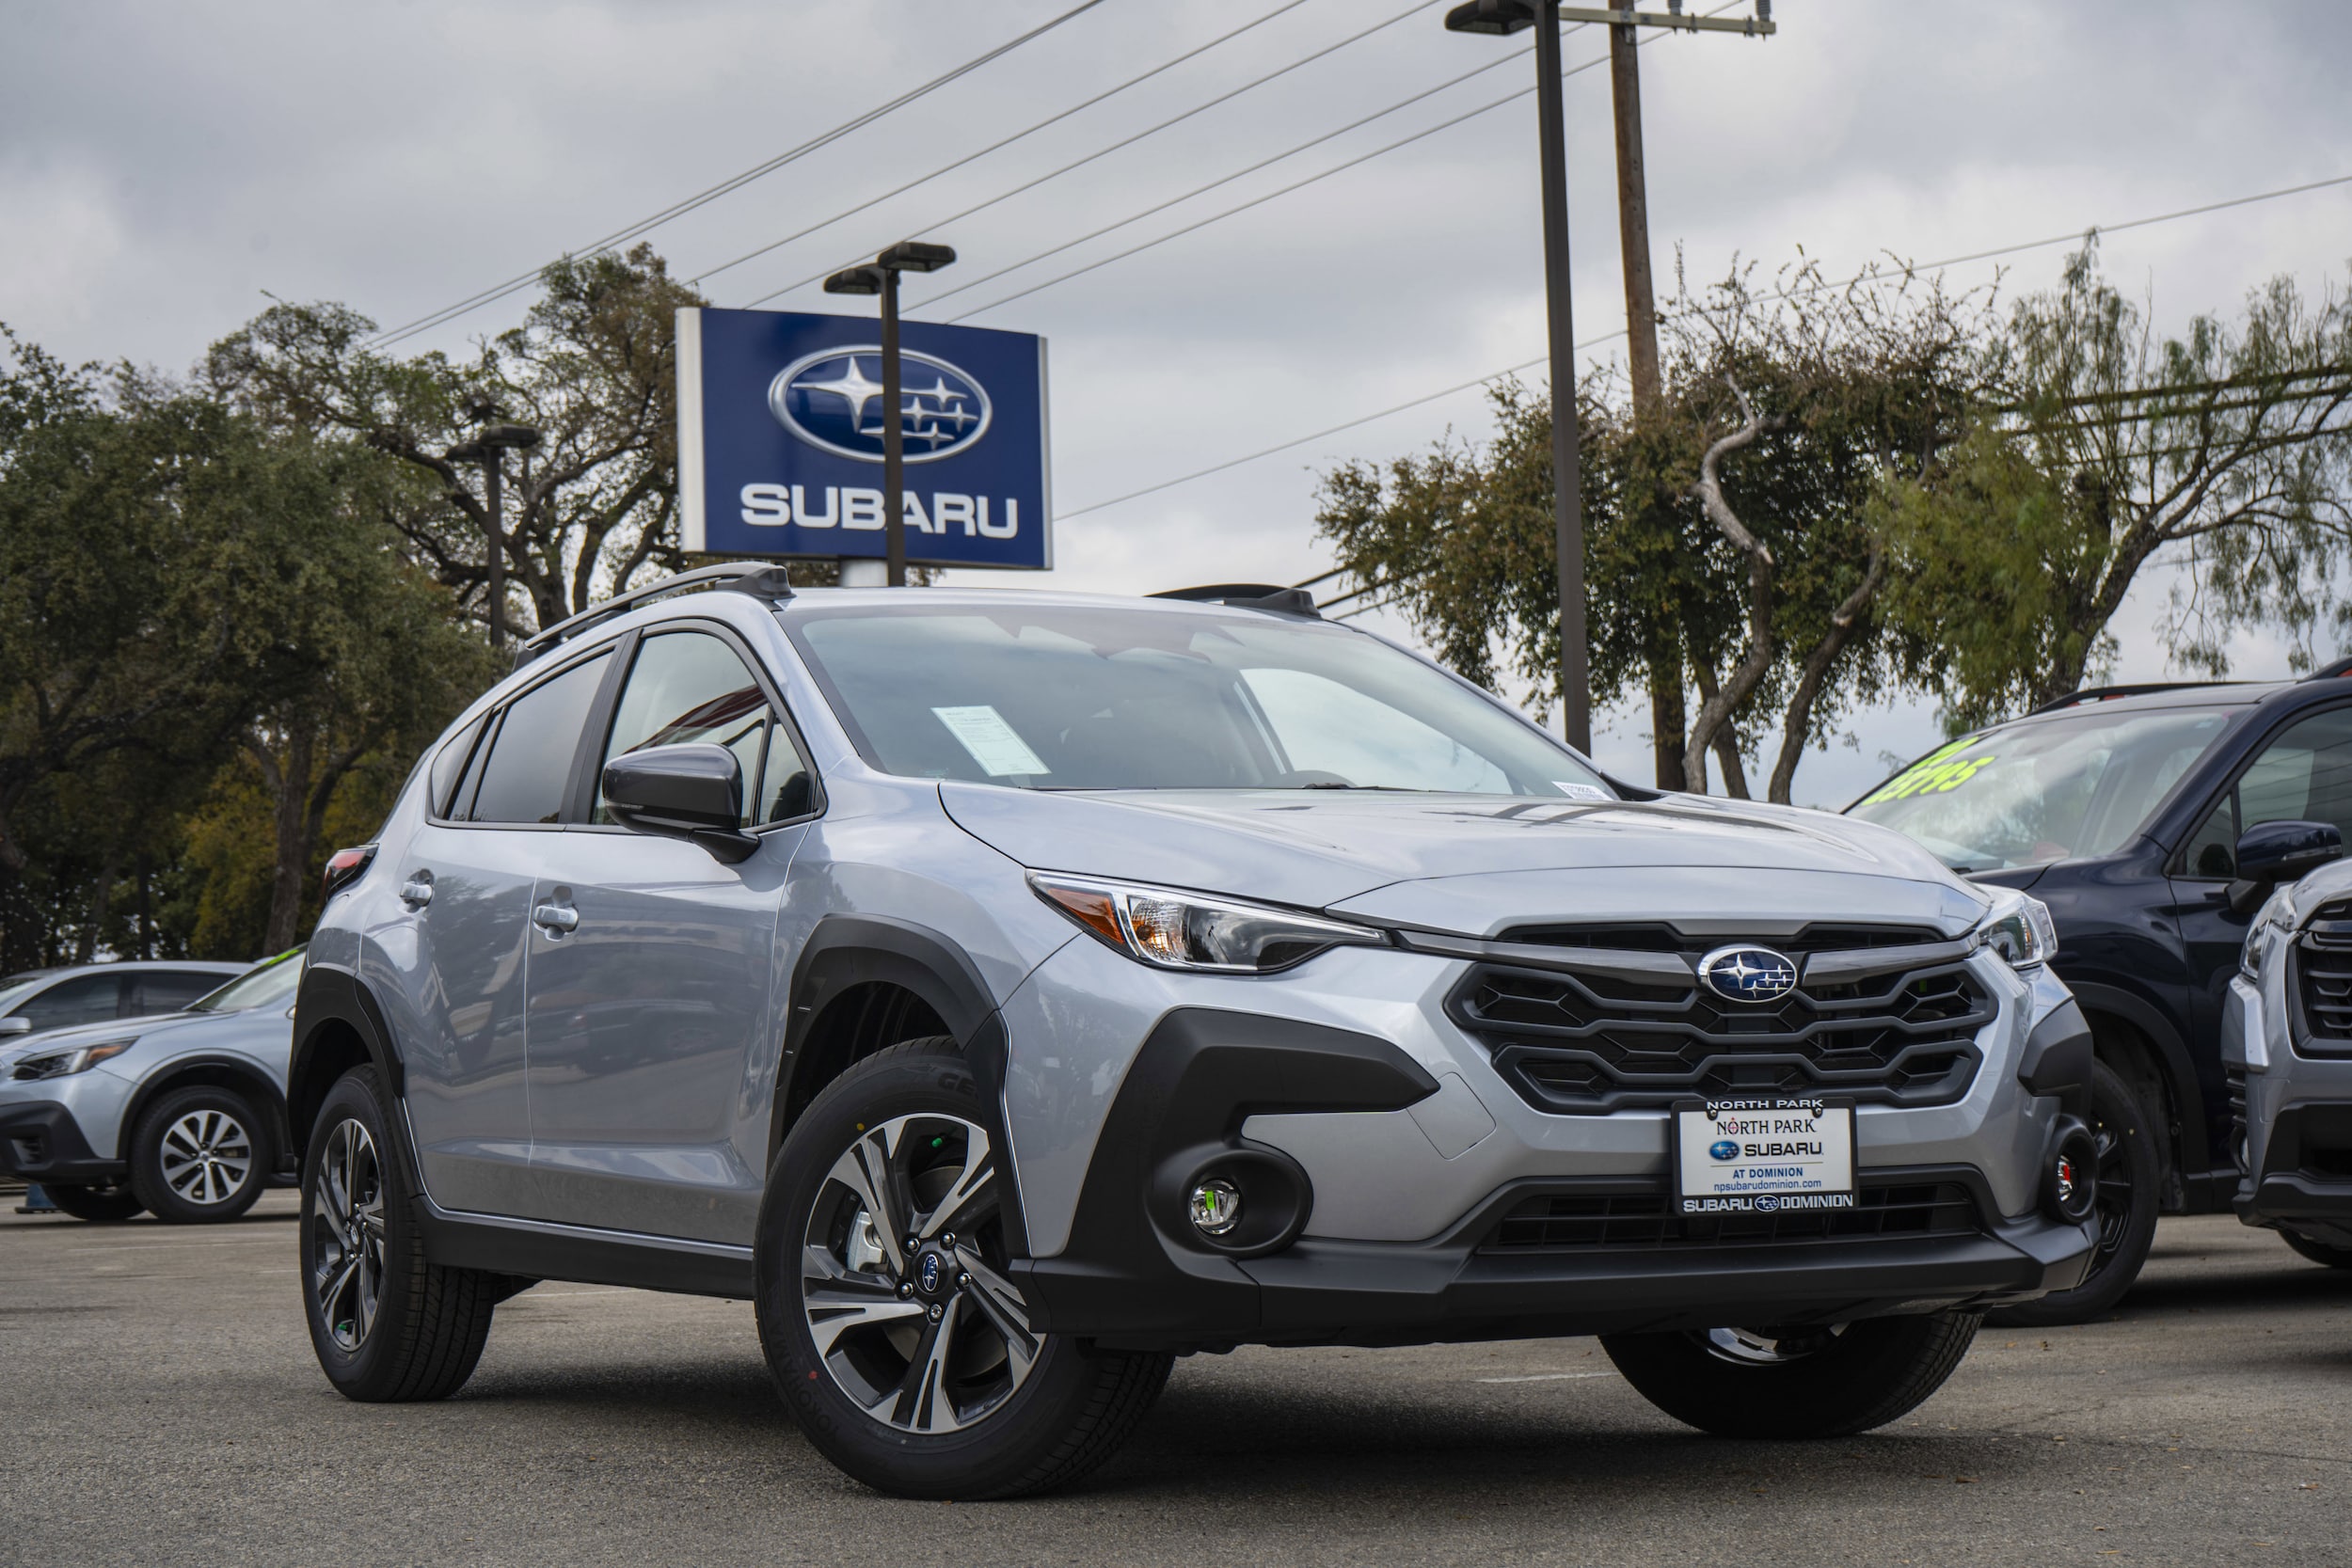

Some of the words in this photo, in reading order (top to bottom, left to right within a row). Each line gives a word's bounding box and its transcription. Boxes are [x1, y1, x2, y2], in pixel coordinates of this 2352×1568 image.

[739, 483, 1018, 539] SUBARU
[1706, 1101, 1770, 1111] NORTH
[1776, 1099, 1824, 1108] PARK
[1716, 1117, 1769, 1135] NORTH
[1774, 1118, 1817, 1133] PARK
[1744, 1142, 1822, 1157] SUBARU
[1733, 1169, 1745, 1180] AT
[1749, 1166, 1804, 1179] DOMINION
[1713, 1179, 1821, 1193] npsubarudominion.com
[1682, 1197, 1753, 1212] SUBARU
[1780, 1194, 1853, 1210] DOMINION
